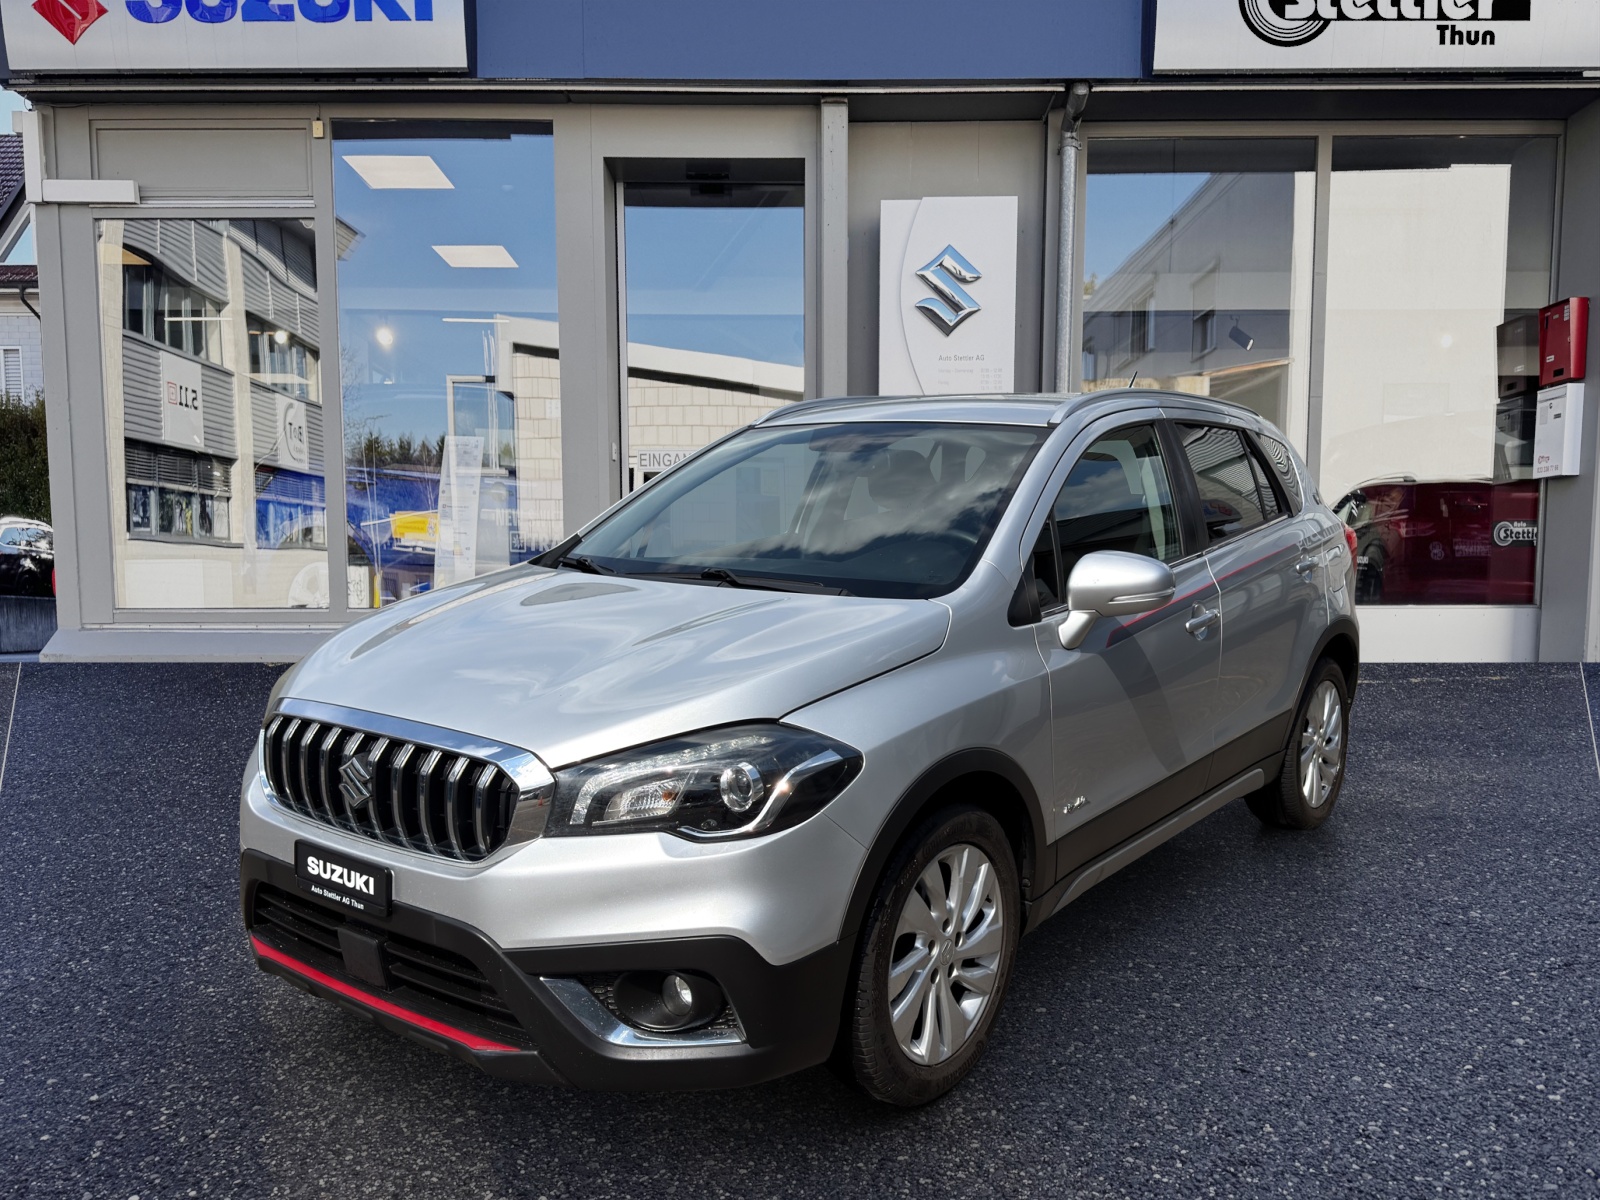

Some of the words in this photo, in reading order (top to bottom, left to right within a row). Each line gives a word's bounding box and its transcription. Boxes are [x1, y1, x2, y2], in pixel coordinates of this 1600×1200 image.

[1436, 25, 1495, 45] Thun
[307, 856, 375, 895] SUZUKI
[311, 885, 323, 895] Auto
[341, 896, 350, 905] AG
[350, 899, 364, 910] Thun
